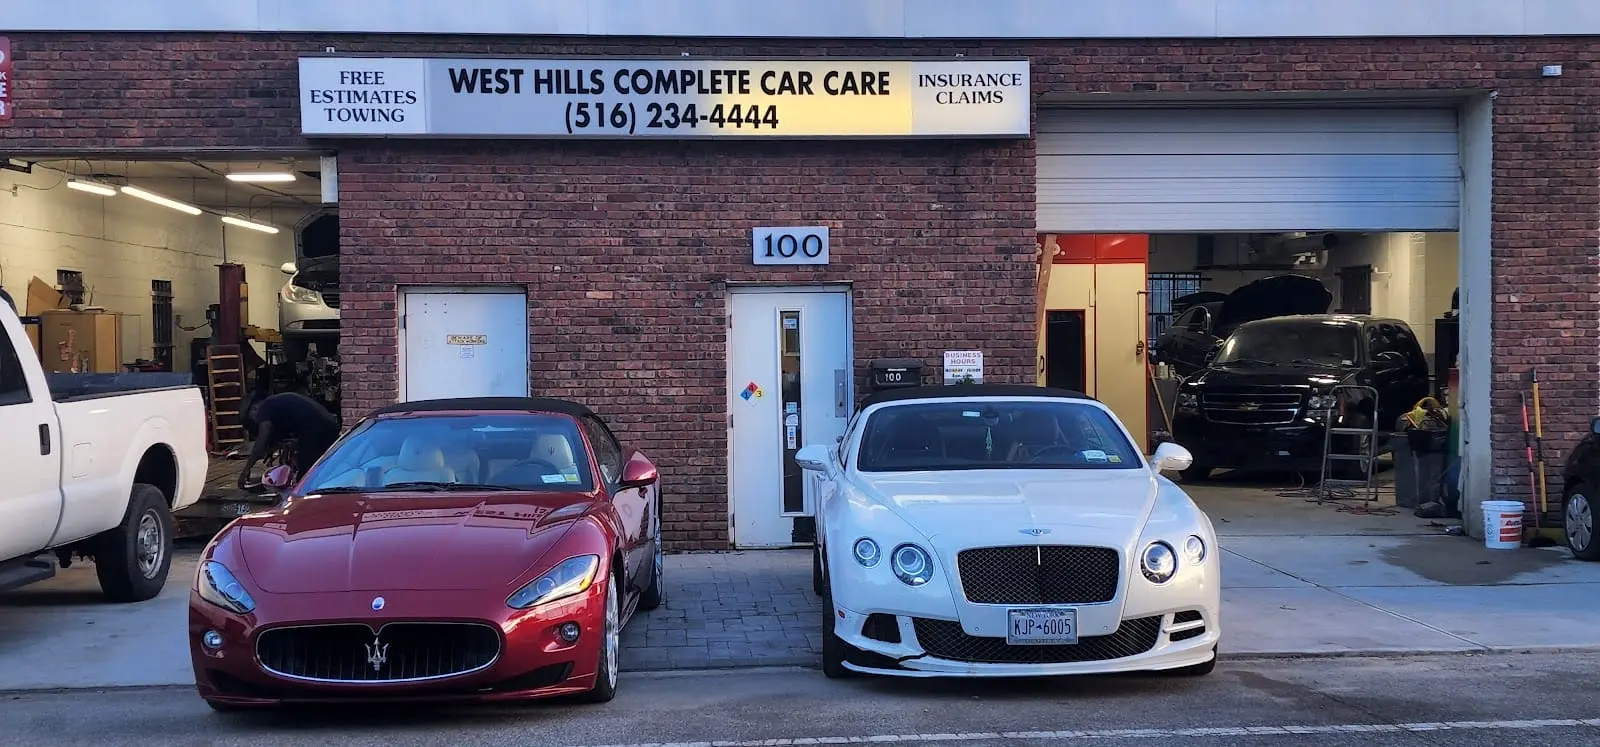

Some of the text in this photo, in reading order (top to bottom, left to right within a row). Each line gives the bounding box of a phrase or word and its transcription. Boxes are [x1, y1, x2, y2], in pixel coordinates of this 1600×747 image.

[340, 71, 385, 85] FREE
[449, 68, 890, 96] WEST HILLS COMPLETE CAR CARE
[918, 73, 1022, 88] INSURANCE
[310, 89, 417, 105] ESTIMATES
[936, 91, 1004, 105] CLAIMS
[323, 107, 405, 123] TOWING
[565, 102, 779, 135] (516) 234-4444
[764, 233, 823, 258] 100
[885, 372, 902, 382] 100
[756, 390, 762, 398] 3
